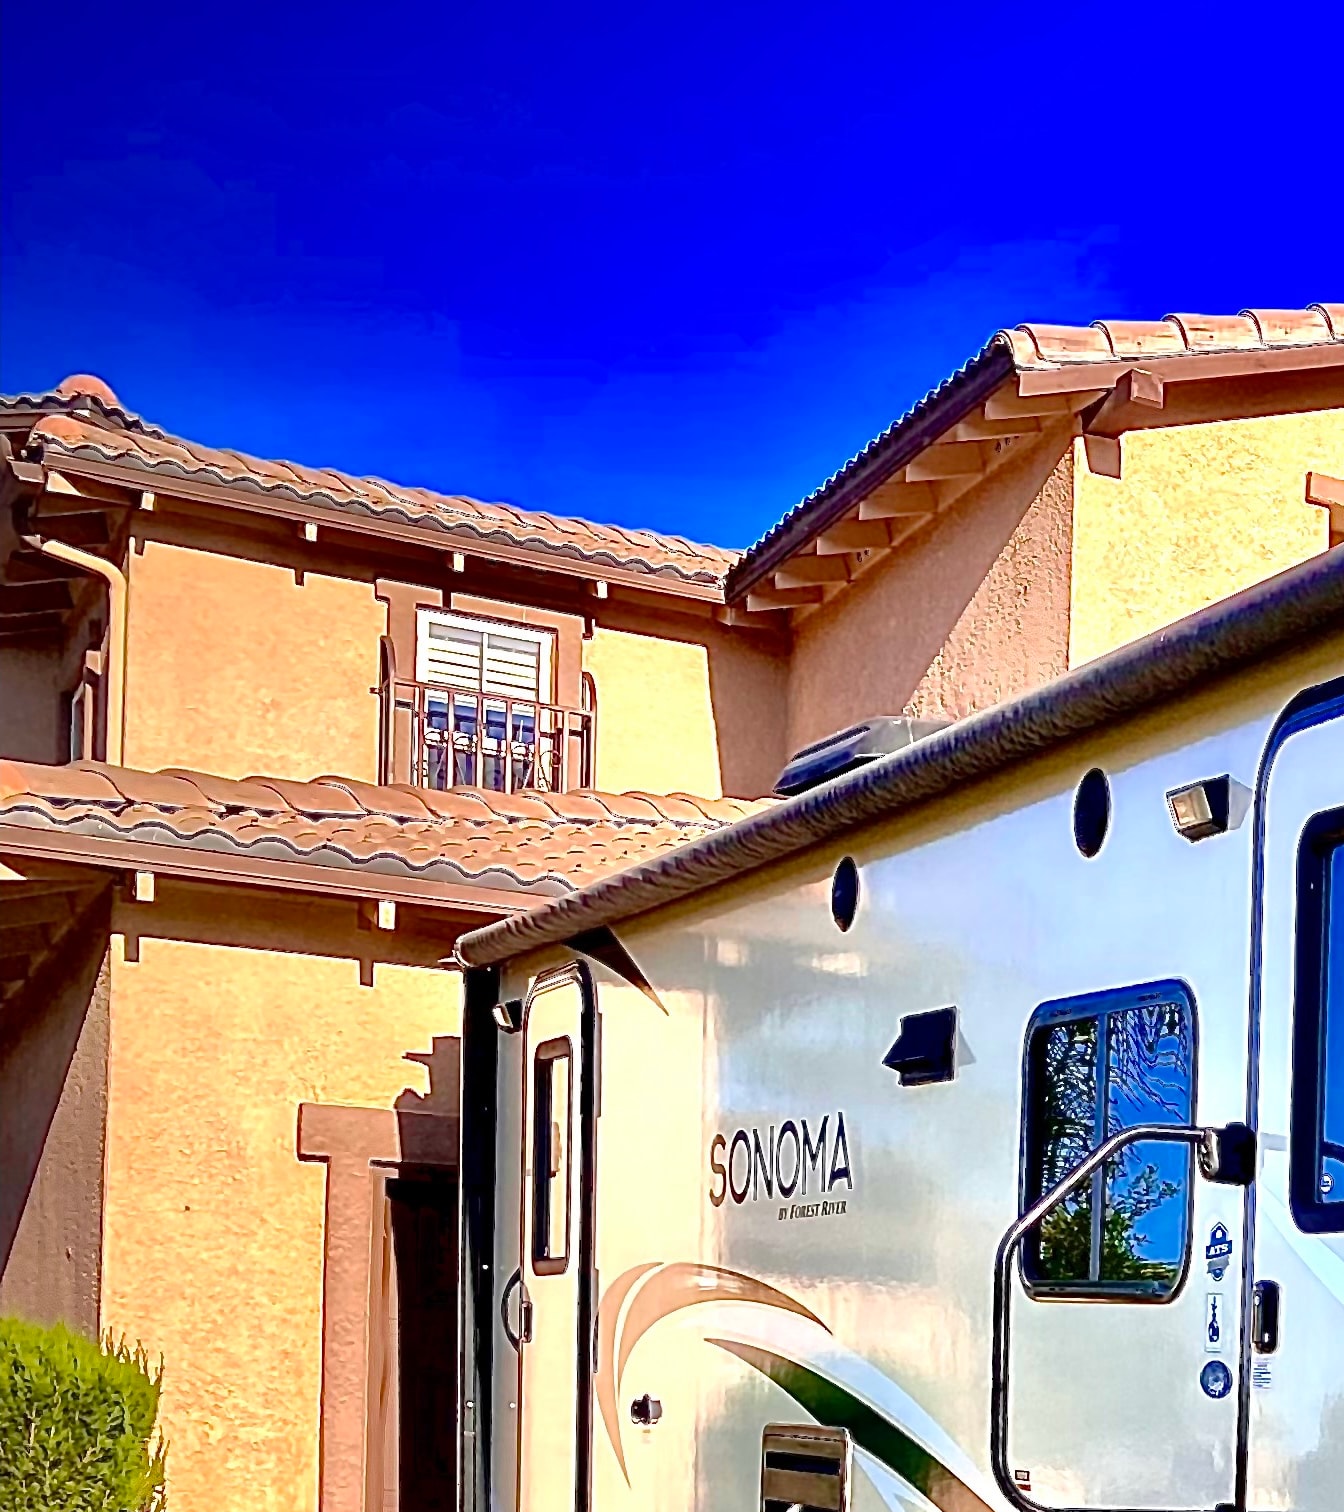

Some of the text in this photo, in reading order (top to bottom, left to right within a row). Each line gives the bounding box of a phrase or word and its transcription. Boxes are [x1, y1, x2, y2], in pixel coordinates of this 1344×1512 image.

[708, 1111, 853, 1208] SONOMA
[778, 1200, 847, 1220] BY FOREST RIVER
